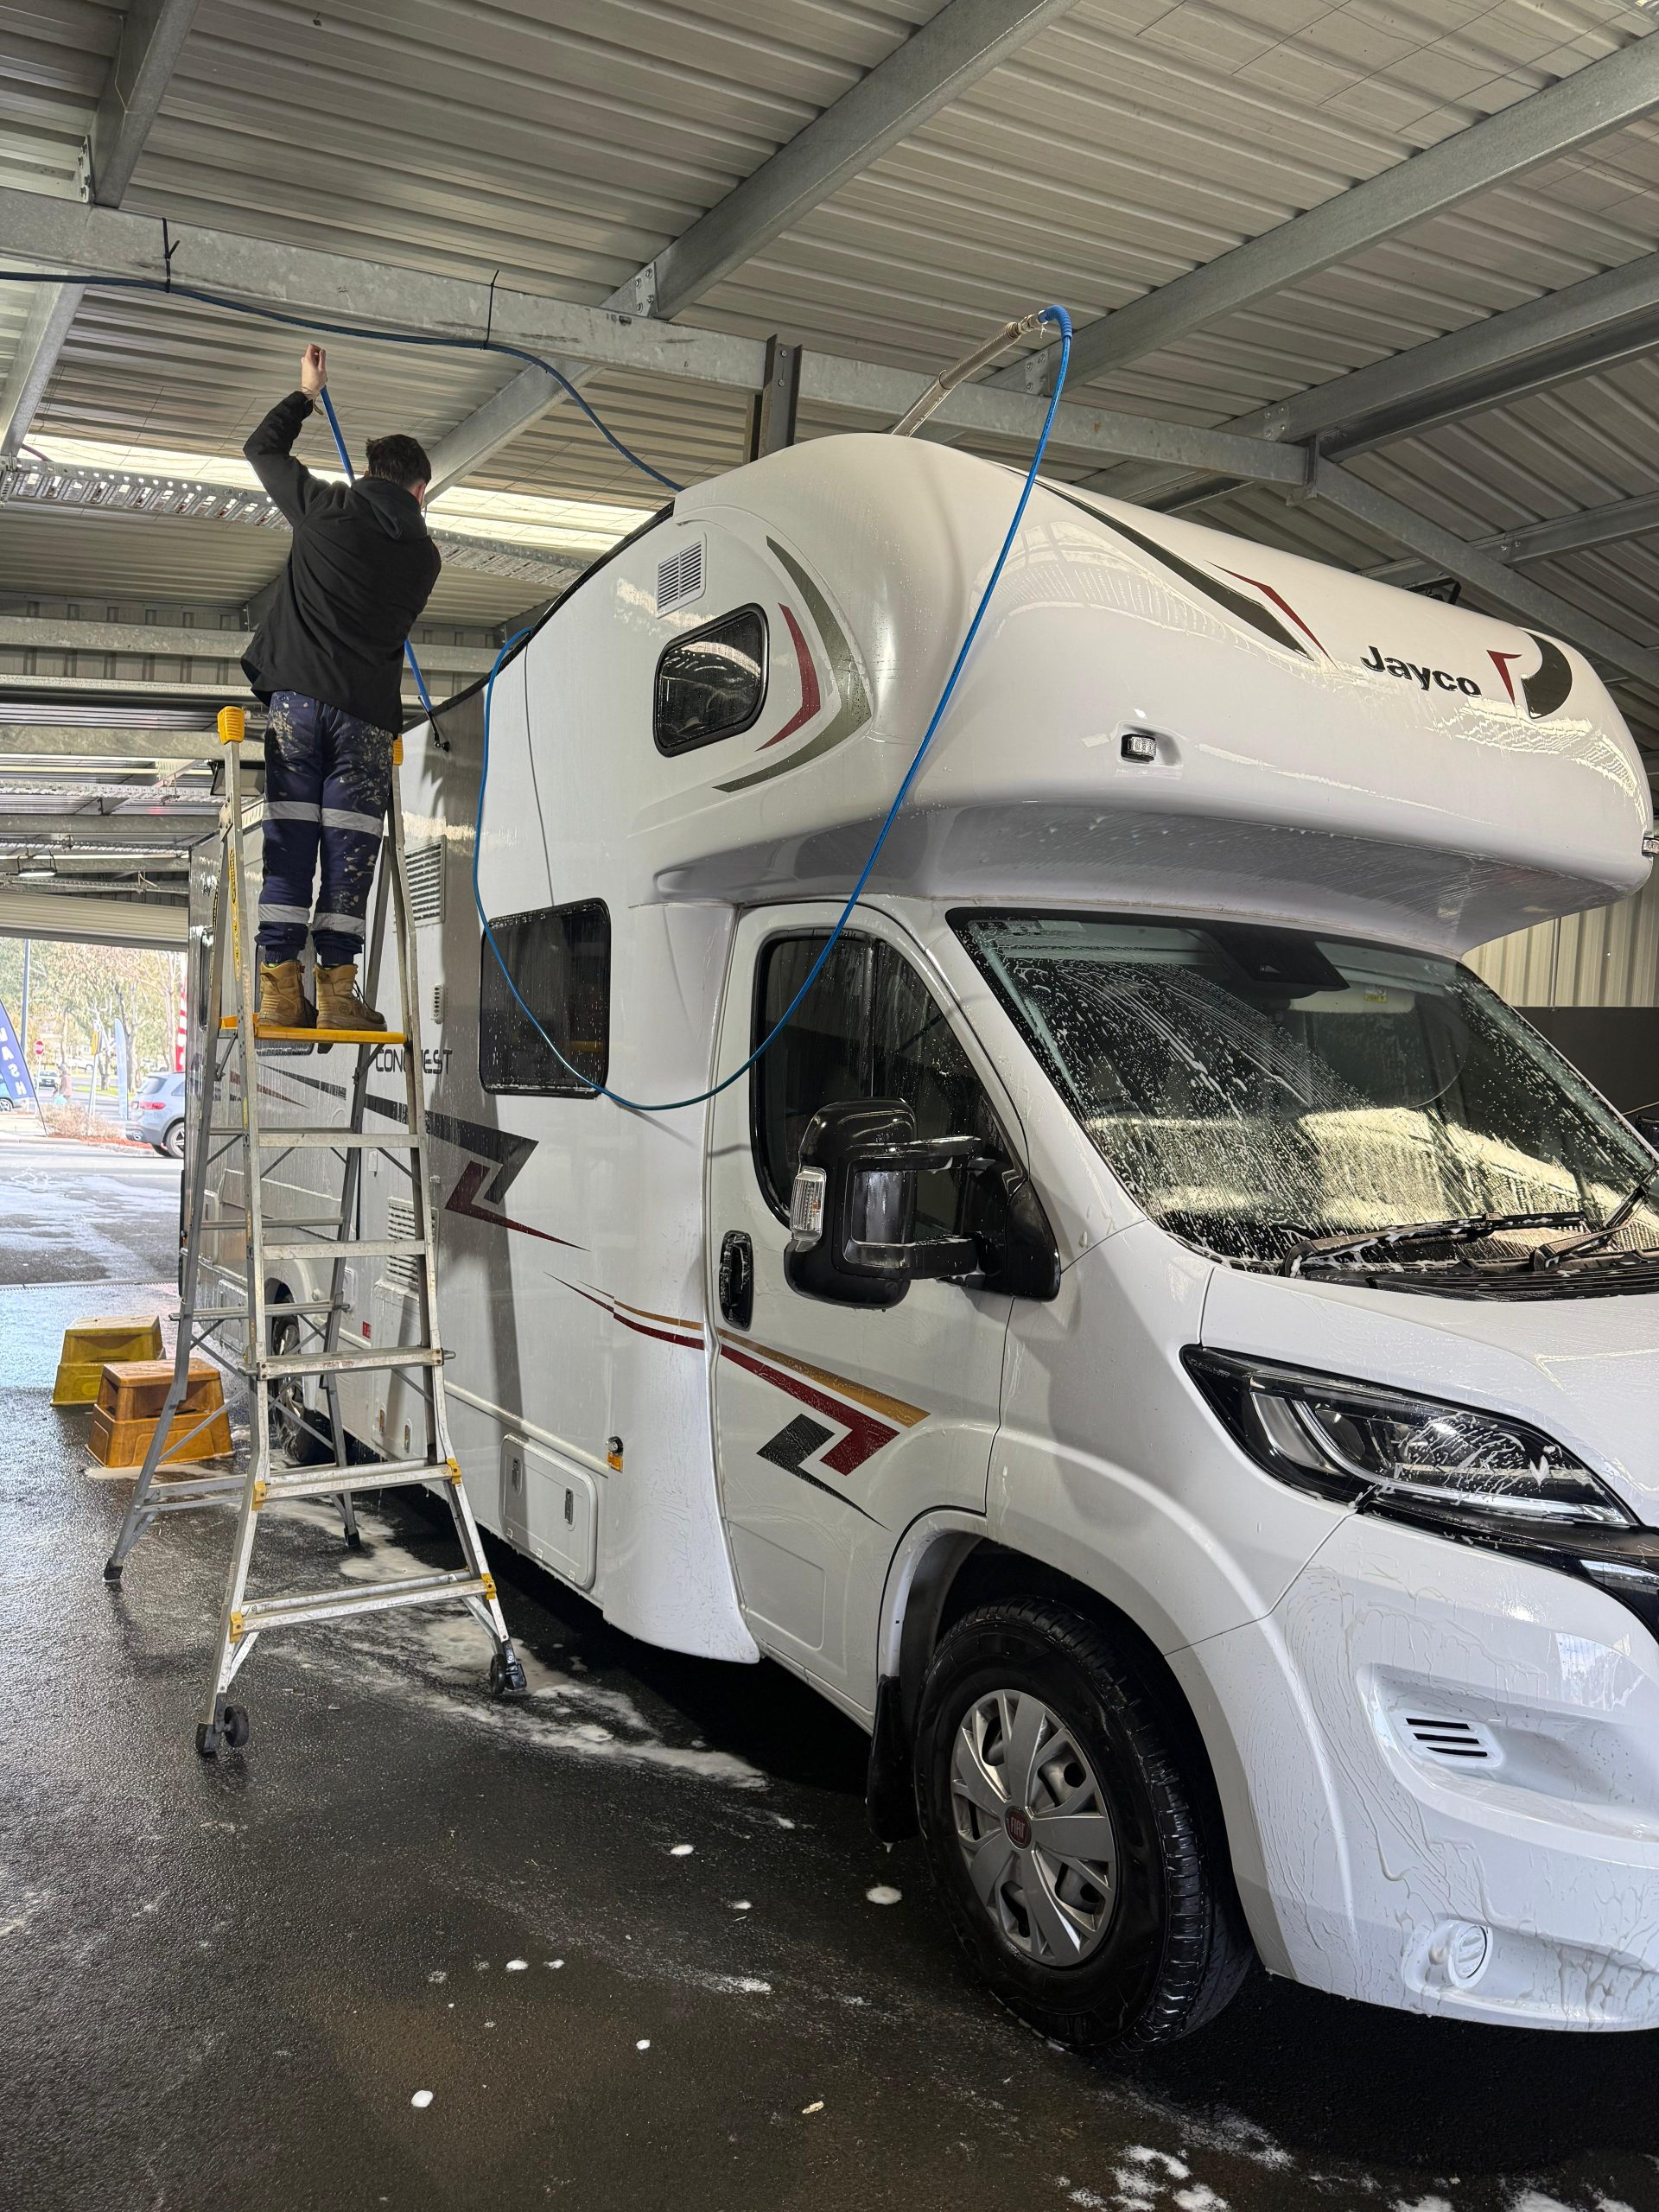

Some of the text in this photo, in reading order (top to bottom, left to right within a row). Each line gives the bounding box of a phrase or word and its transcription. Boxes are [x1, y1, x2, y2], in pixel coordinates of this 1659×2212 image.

[1359, 645, 1482, 698] Jayco
[375, 1048, 453, 1074] CONEST
[1010, 1816, 1025, 1838] FIAT
